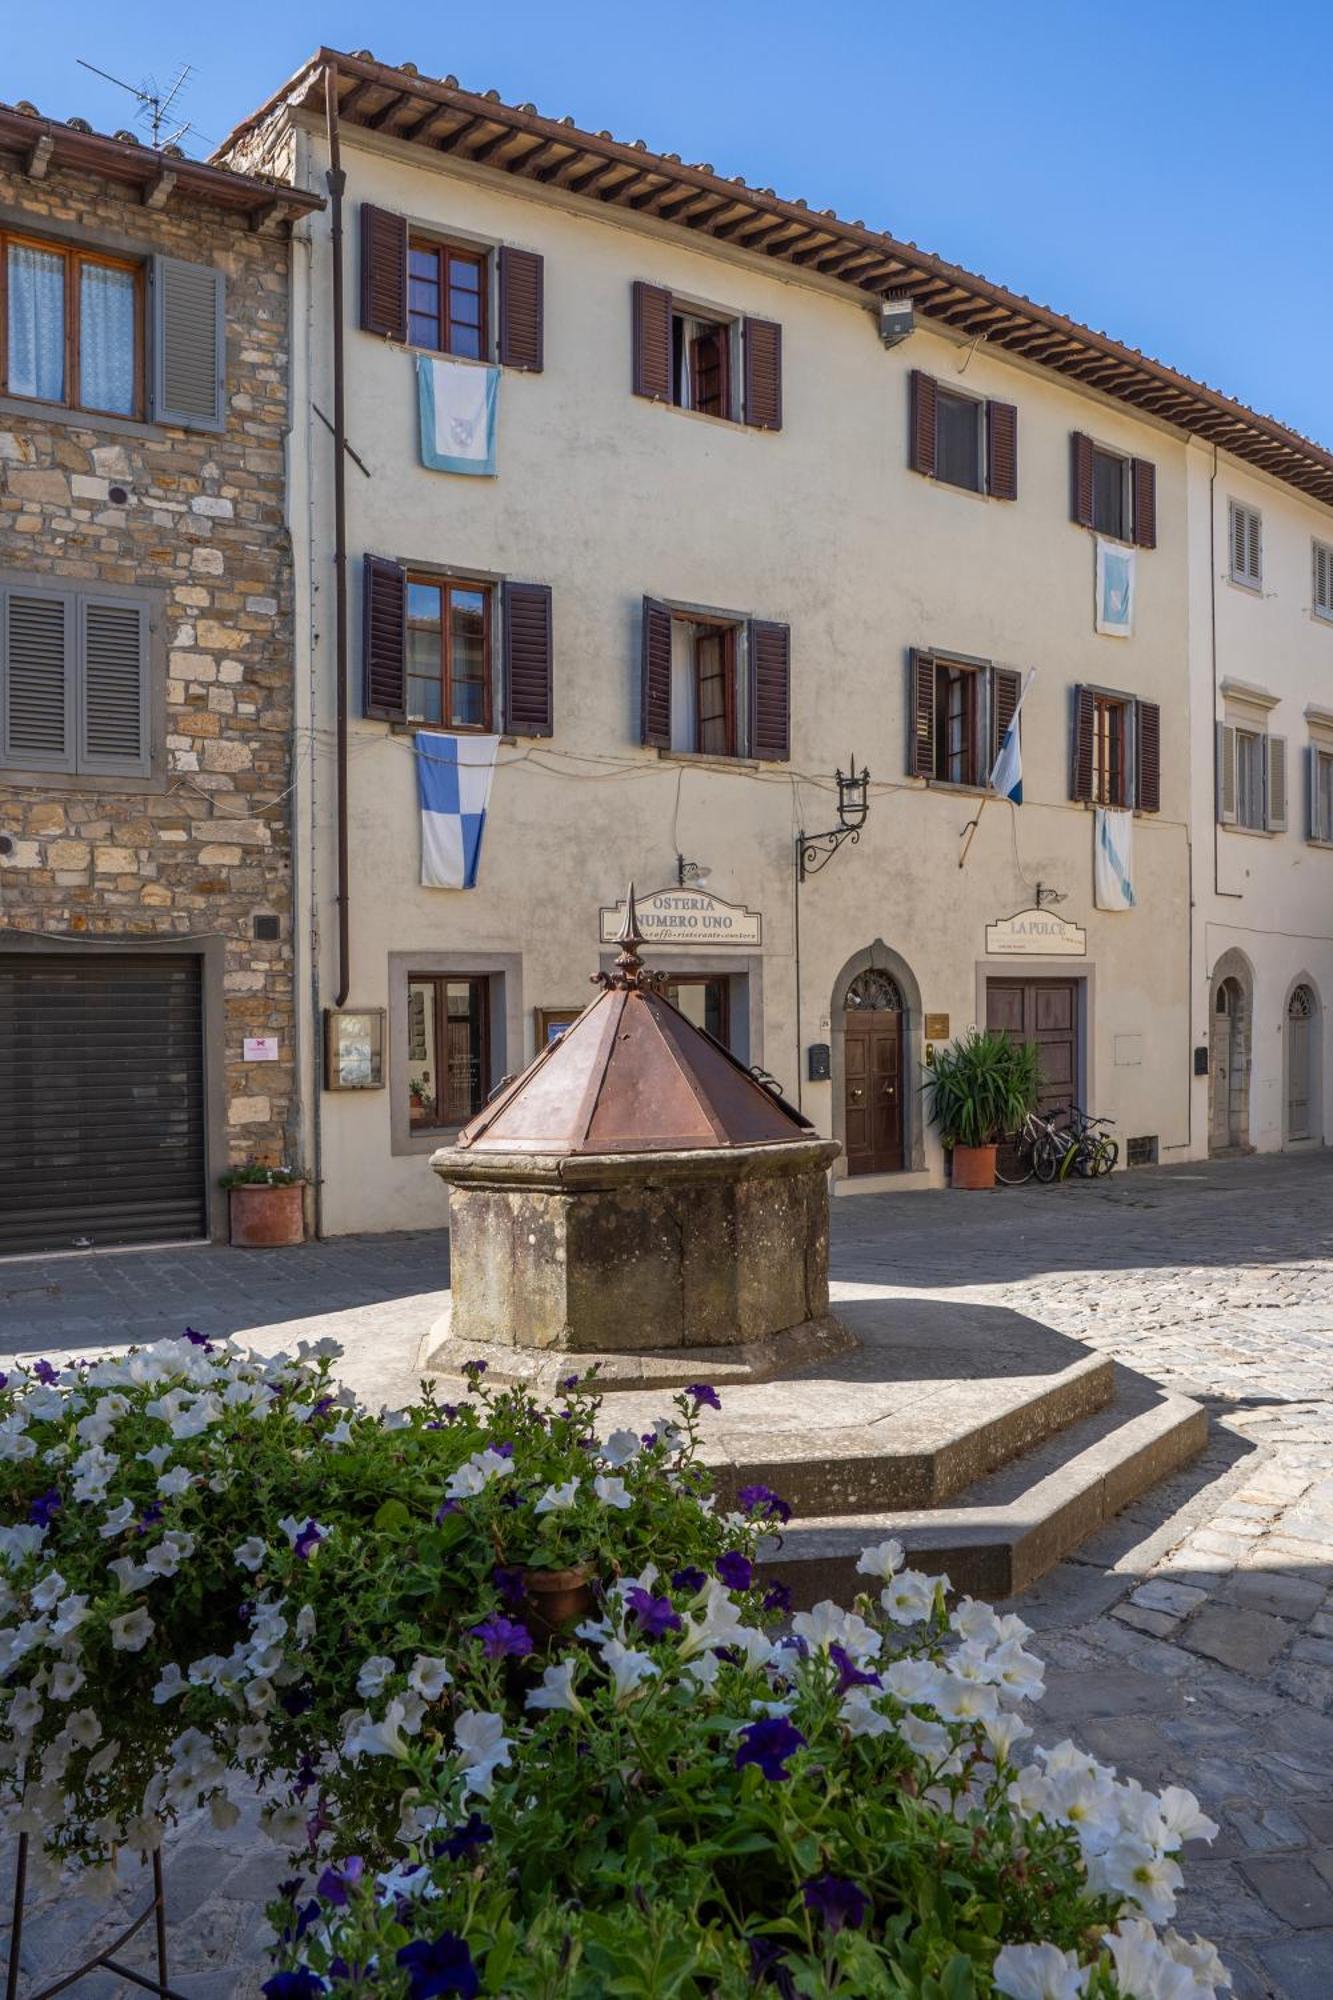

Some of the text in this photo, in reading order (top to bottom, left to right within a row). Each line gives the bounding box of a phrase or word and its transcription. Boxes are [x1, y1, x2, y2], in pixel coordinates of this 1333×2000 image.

[653, 896, 715, 911] OSTERIA
[636, 914, 733, 929] NUMERO UNO
[1011, 921, 1026, 934] LA
